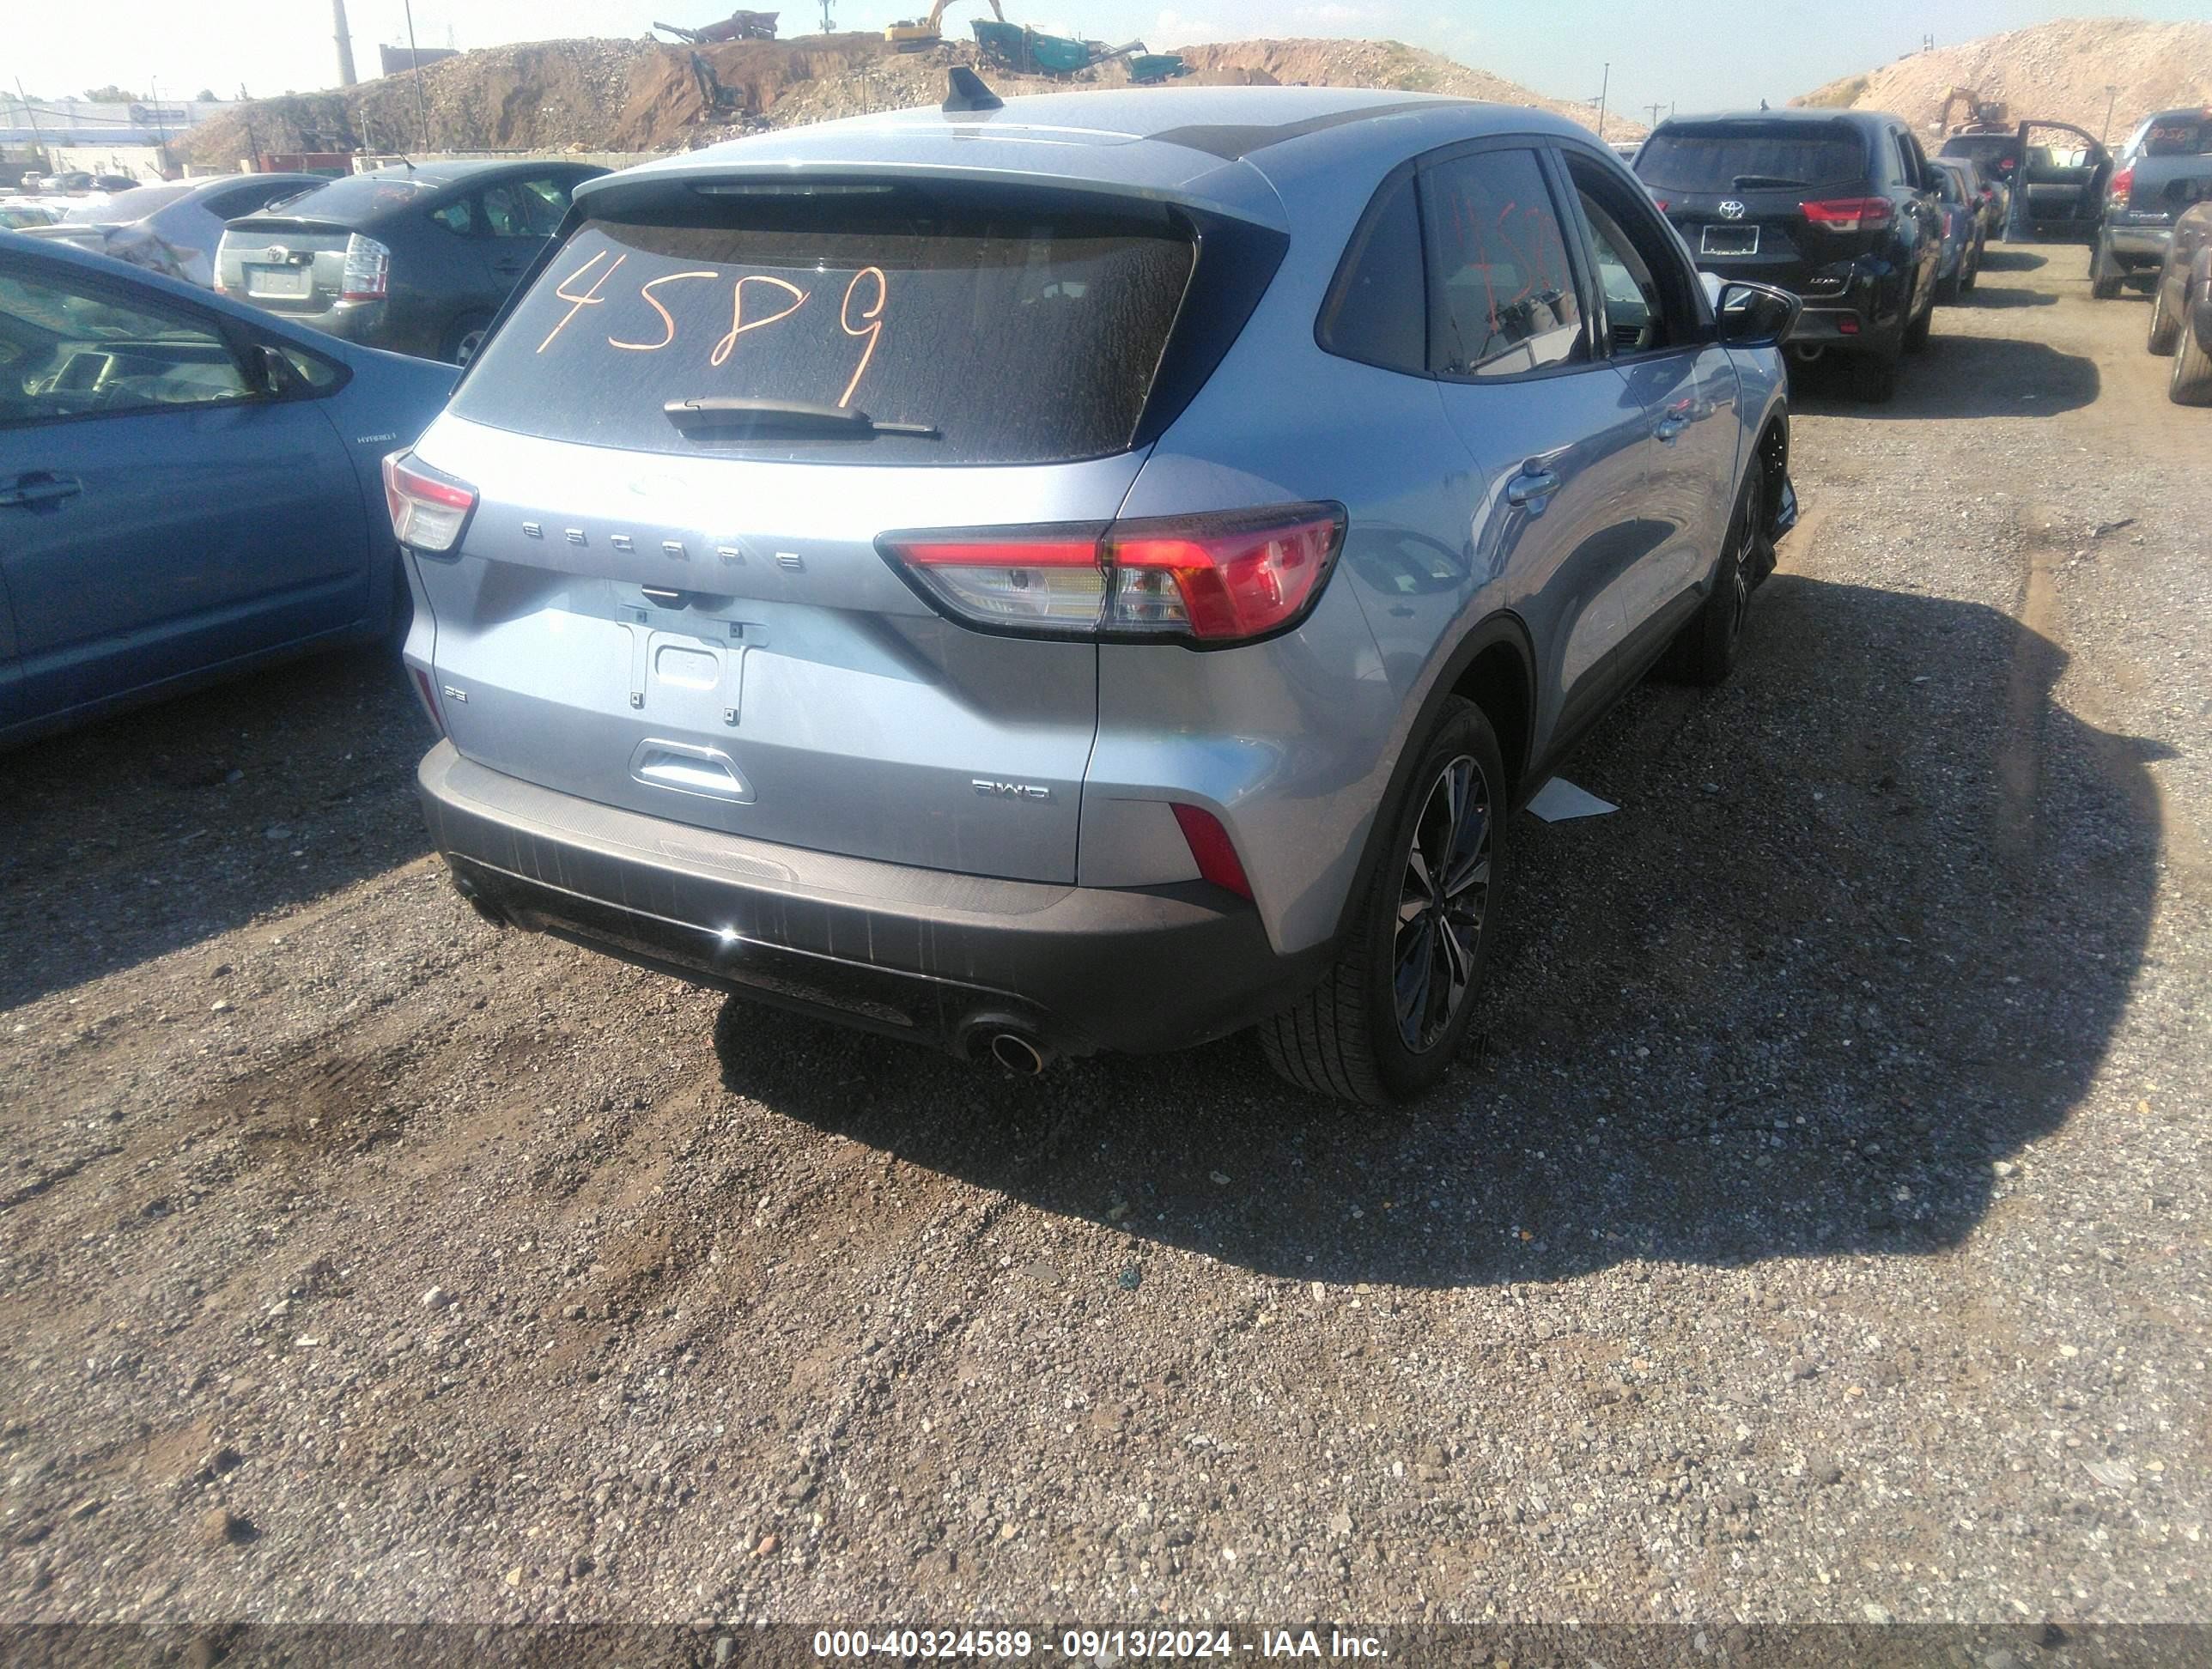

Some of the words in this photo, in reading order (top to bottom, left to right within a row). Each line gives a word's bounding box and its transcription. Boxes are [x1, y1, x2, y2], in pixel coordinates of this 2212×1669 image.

[537, 250, 887, 408] 4589
[522, 521, 803, 568] ESCAPE
[444, 685, 467, 702] SE
